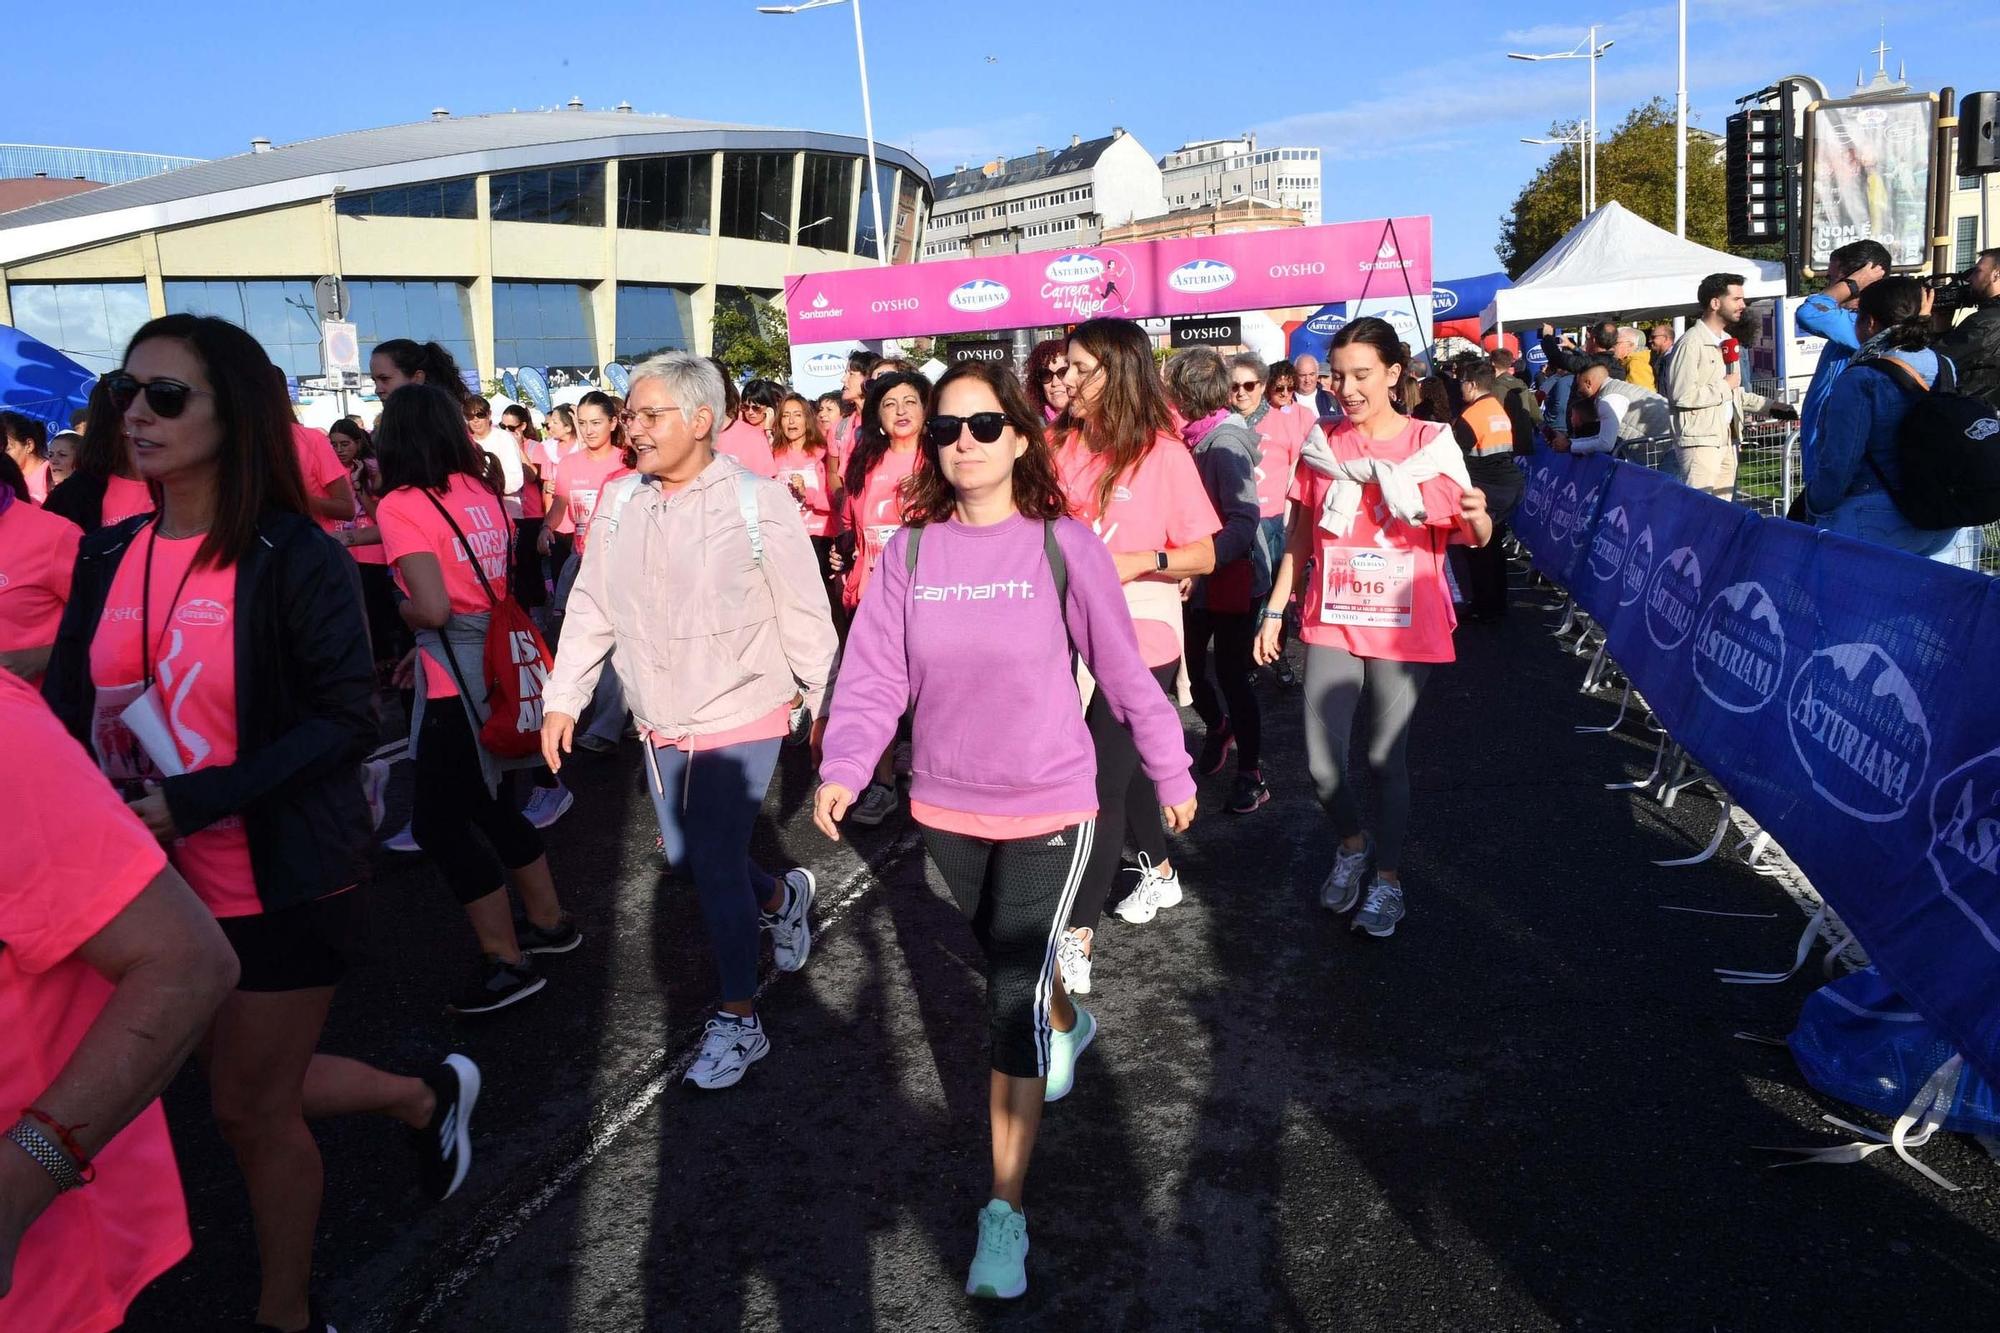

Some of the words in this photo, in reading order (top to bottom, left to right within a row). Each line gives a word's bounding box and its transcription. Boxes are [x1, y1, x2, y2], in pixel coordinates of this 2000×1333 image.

[1049, 264, 1101, 278] ASTURIANA
[1269, 262, 1325, 278] OYSHO
[1359, 258, 1414, 272] Santander
[1173, 272, 1231, 286] ASTURIANA
[953, 290, 1006, 306] ASTURIANA
[1040, 282, 1090, 299] Carrera
[871, 297, 920, 313] OYSHO
[1070, 292, 1109, 319] Mujer
[799, 307, 844, 320] Santander
[1180, 326, 1232, 341] OYSHO
[957, 349, 1004, 361] OYSHO
[464, 506, 493, 530] TU
[1352, 580, 1385, 594] 016
[1697, 612, 1773, 696] ASTURIANA
[1791, 677, 1911, 806] ASTURIANA
